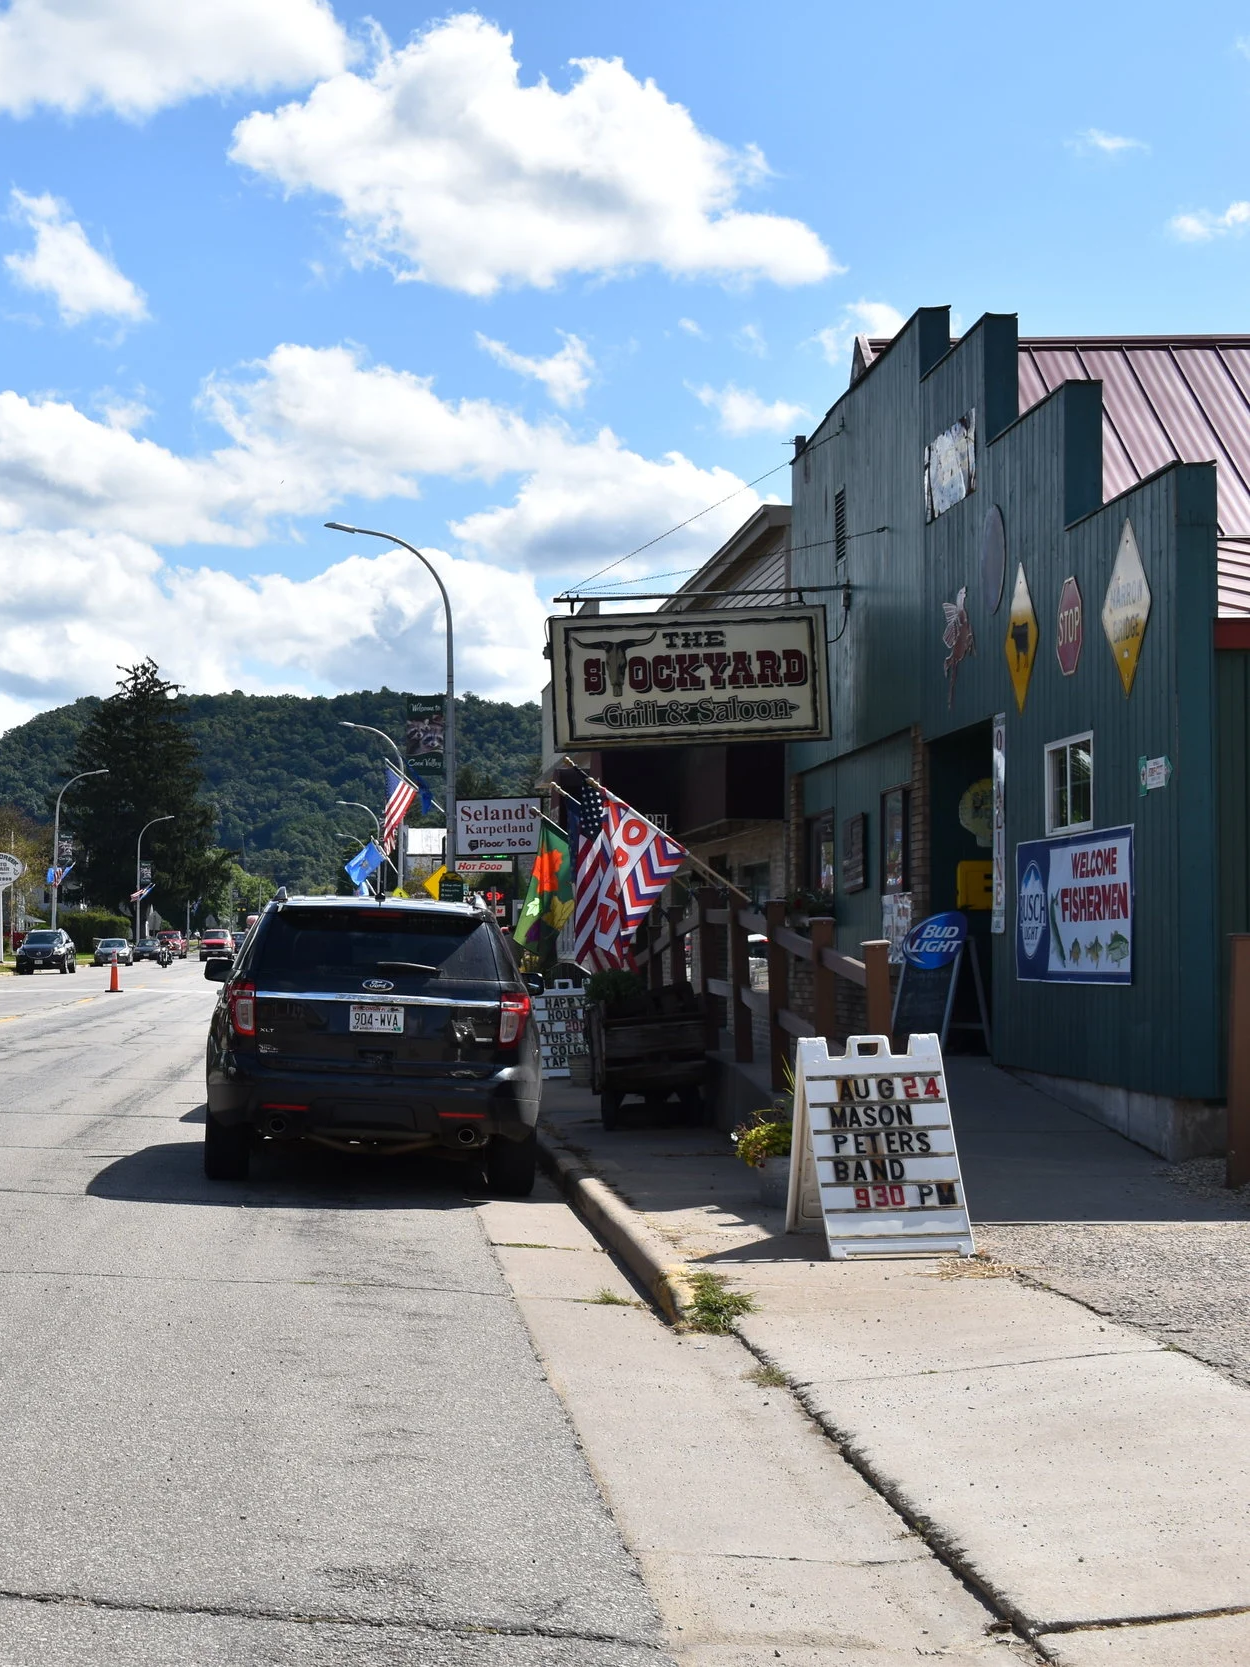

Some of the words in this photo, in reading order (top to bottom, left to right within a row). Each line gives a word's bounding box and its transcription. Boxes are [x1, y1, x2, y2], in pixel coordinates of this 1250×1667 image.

[1109, 578, 1143, 609] NARROW
[1058, 605, 1080, 646] STOP
[1112, 612, 1140, 643] BRIDGE
[662, 630, 726, 649] THE
[603, 700, 659, 729] Grill
[666, 699, 691, 725] &
[696, 696, 792, 725] Saloon
[460, 803, 537, 822] Seland's
[465, 822, 534, 836] Karpetland
[479, 840, 504, 848] Floors
[506, 839, 517, 847] To
[518, 838, 531, 847] Go
[458, 862, 476, 870] HOT
[478, 862, 502, 870] FOOD
[1071, 847, 1118, 879] WELCOME
[1060, 882, 1128, 923] FISHERMEN
[921, 924, 959, 938] BUD
[910, 939, 962, 953] LIGHT
[369, 980, 387, 988] Ford
[545, 996, 584, 1008] HAPPY
[354, 1012, 398, 1026] 904-WVA
[548, 1009, 578, 1020] HOUR
[540, 1022, 554, 1033] AT
[543, 1058, 566, 1068] TAP
[839, 1078, 894, 1101] AUG
[902, 1076, 940, 1098] 24
[829, 1105, 913, 1128] MASON
[832, 1131, 931, 1154] PETERS
[833, 1159, 905, 1181] BAND
[854, 1185, 906, 1208] 930
[918, 1183, 958, 1205] PM
